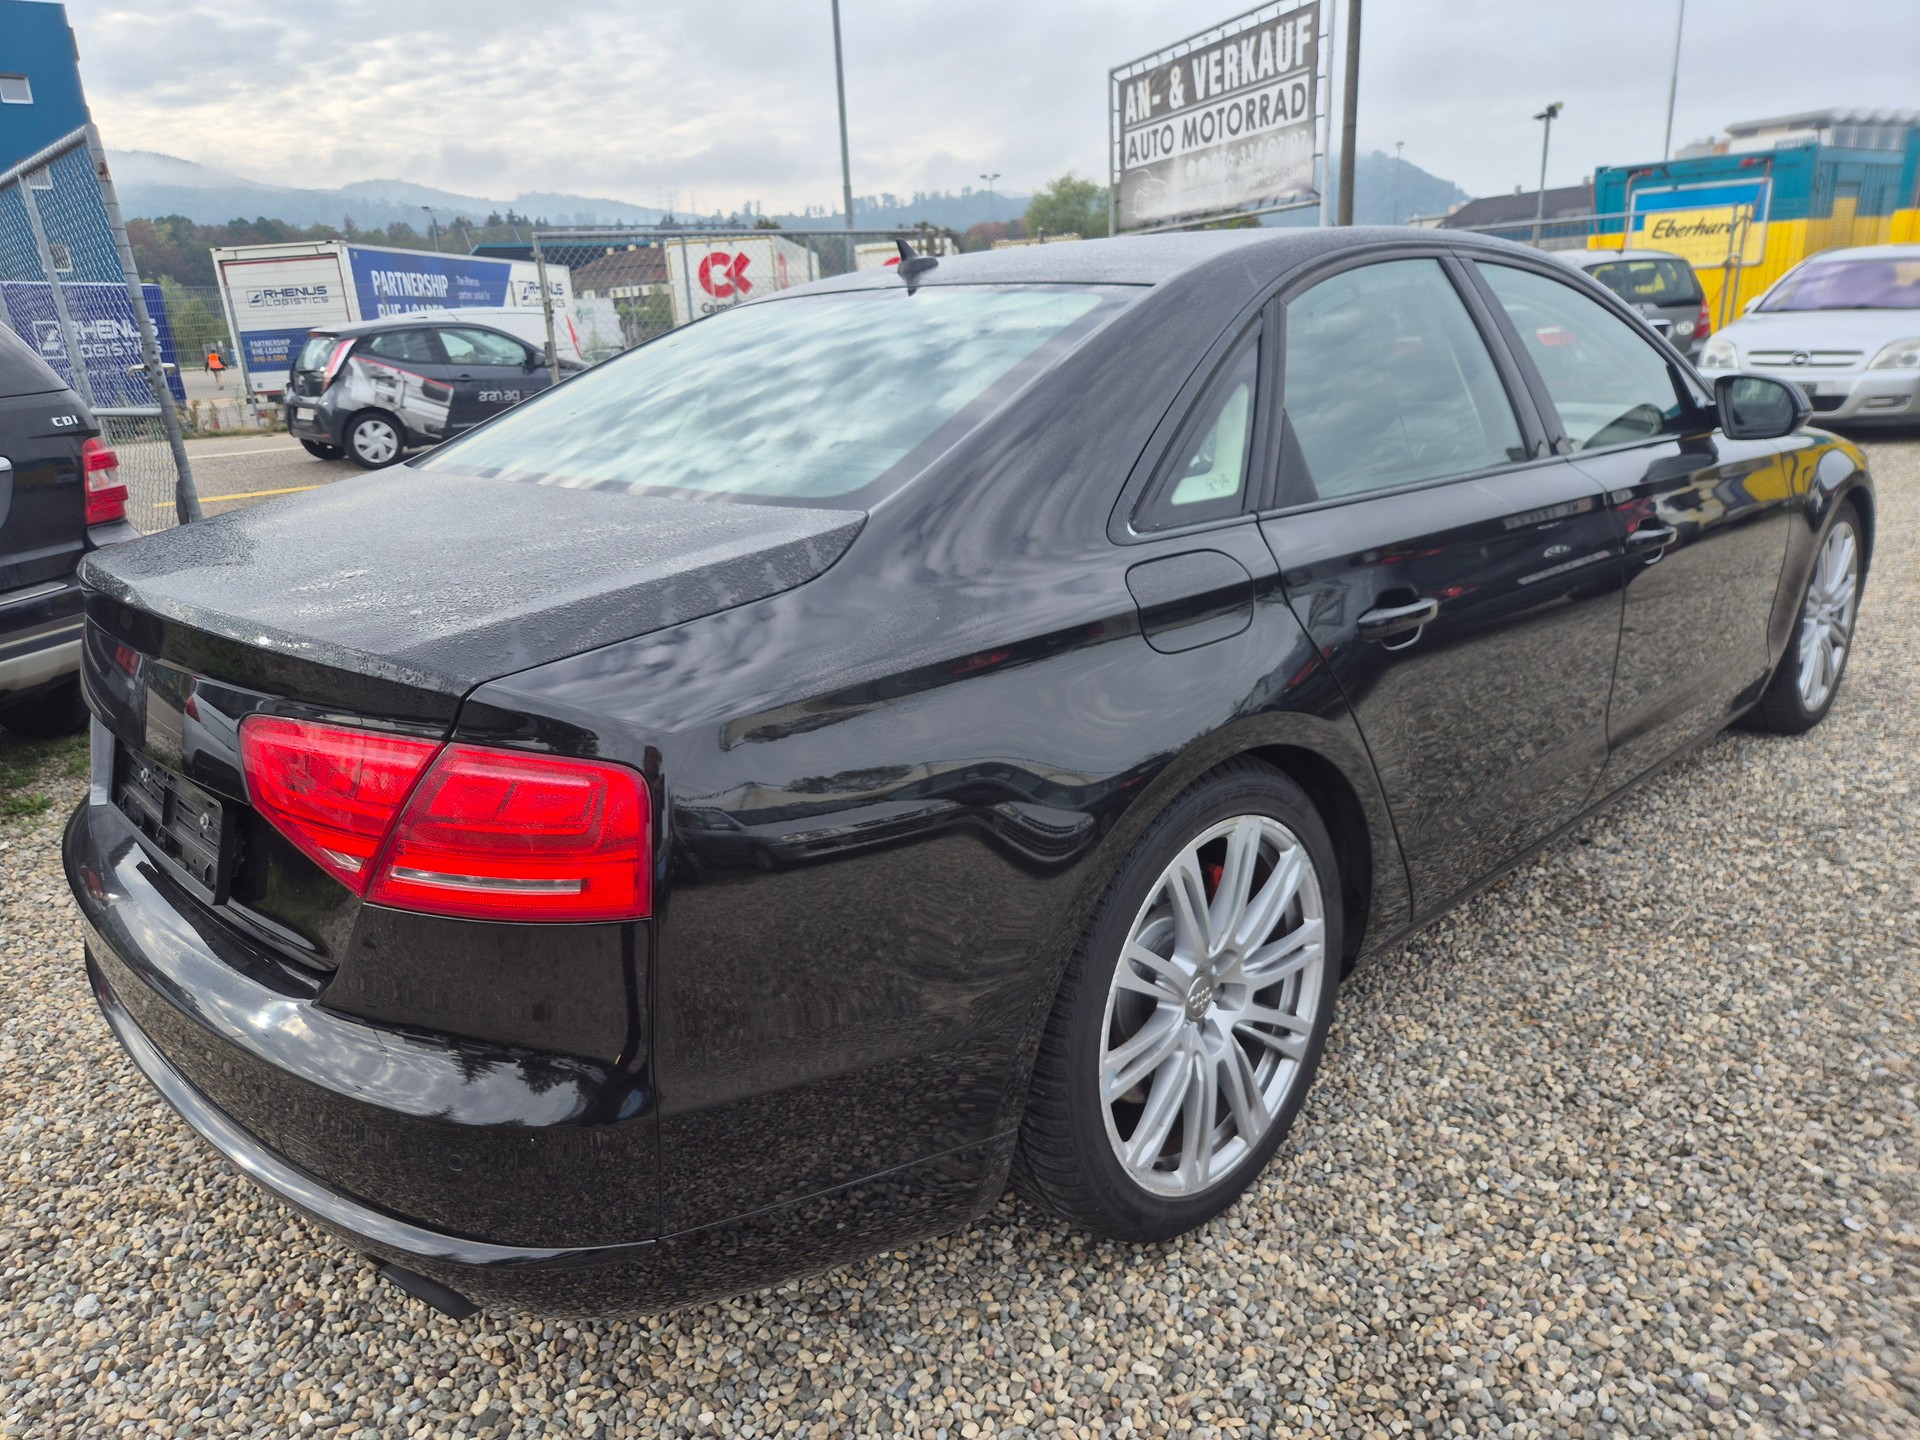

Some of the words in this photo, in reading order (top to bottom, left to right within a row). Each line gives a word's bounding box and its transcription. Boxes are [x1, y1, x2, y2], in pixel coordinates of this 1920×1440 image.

[1124, 78, 1161, 125] AN-
[1168, 65, 1186, 110] &
[1191, 13, 1313, 102] VERKAUF
[1126, 124, 1175, 166] AUTO
[1181, 82, 1307, 150] MOTORRAD
[370, 270, 449, 298] PARTNERSHIP
[263, 286, 328, 299] RHENUS
[265, 296, 330, 307] LOGISTICS
[249, 338, 291, 349] PARTNERSHIP
[51, 415, 79, 427] CDI
